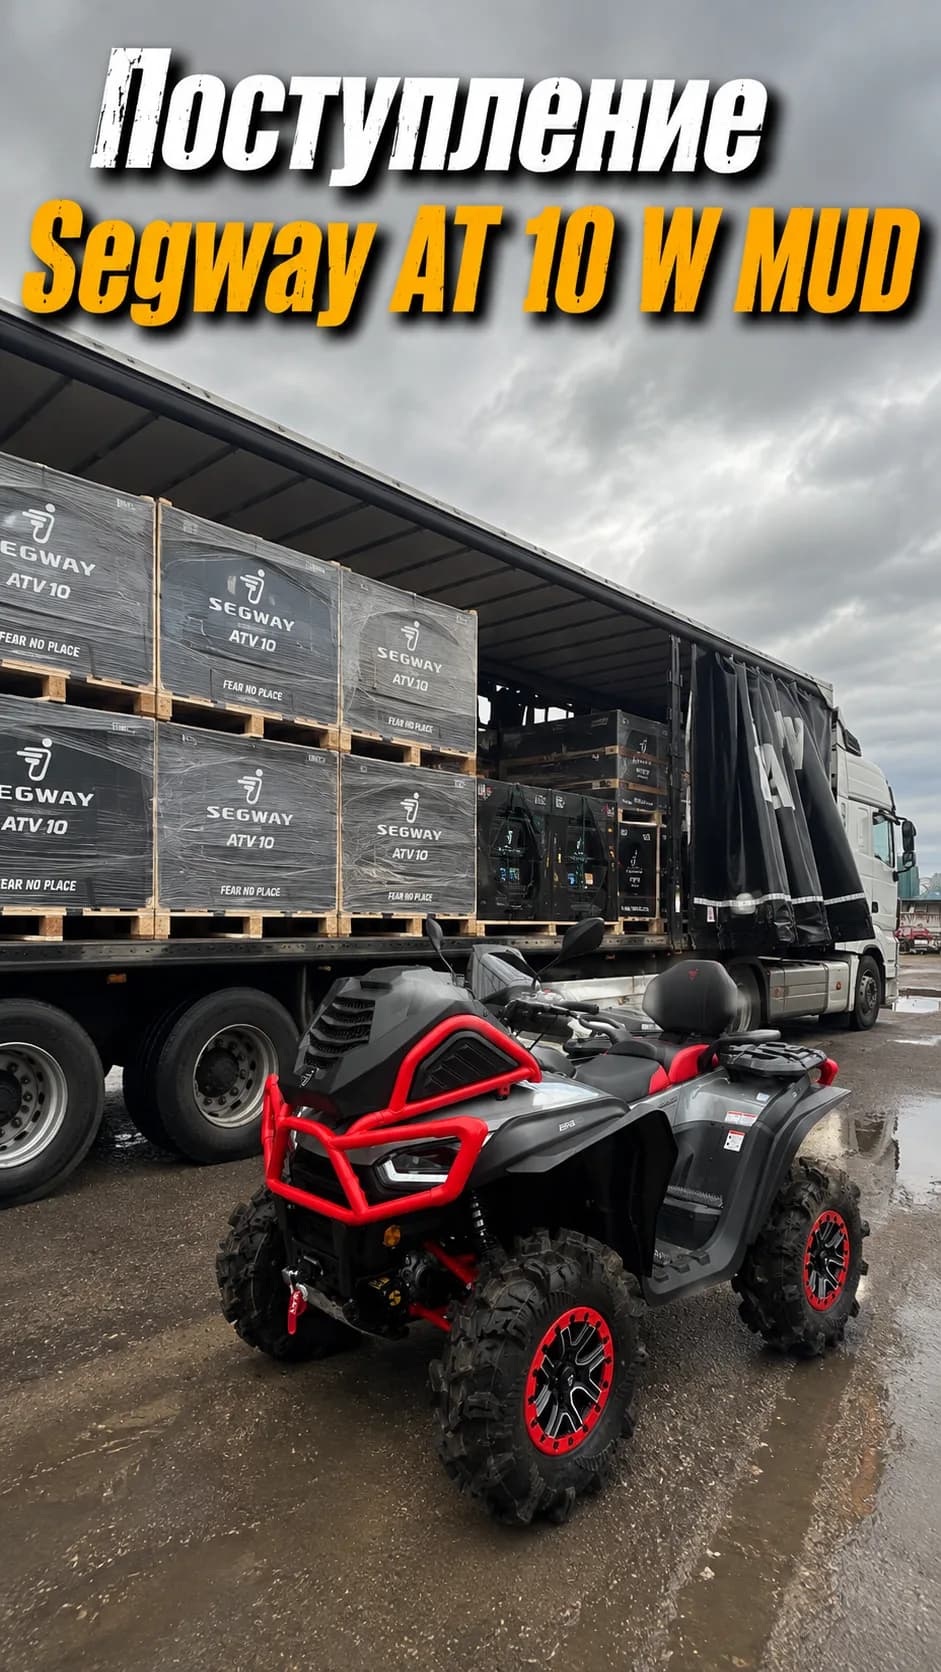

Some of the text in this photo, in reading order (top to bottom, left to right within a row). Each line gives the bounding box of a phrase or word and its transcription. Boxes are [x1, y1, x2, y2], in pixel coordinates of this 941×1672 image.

[0, 540, 96, 577] EGWAY
[6, 573, 72, 600] ATV 10
[208, 596, 295, 632] SEGWAY
[0, 631, 81, 658] FEAR NO PLACE
[228, 629, 277, 652] ATV 10
[376, 646, 443, 674] SEGWAY
[223, 679, 283, 701] FEAR NO PLACE
[392, 673, 429, 692] ATV 10
[0, 784, 95, 807] EGWAY
[1, 816, 69, 835] ATV 10
[206, 805, 294, 826] SEGWAY
[226, 833, 275, 849] ATV 10
[376, 824, 443, 841] SEGWAY
[392, 847, 429, 861] ATV 10
[0, 878, 77, 891] EAR NO PLACE
[220, 885, 281, 897] FEAR NO PLACE
